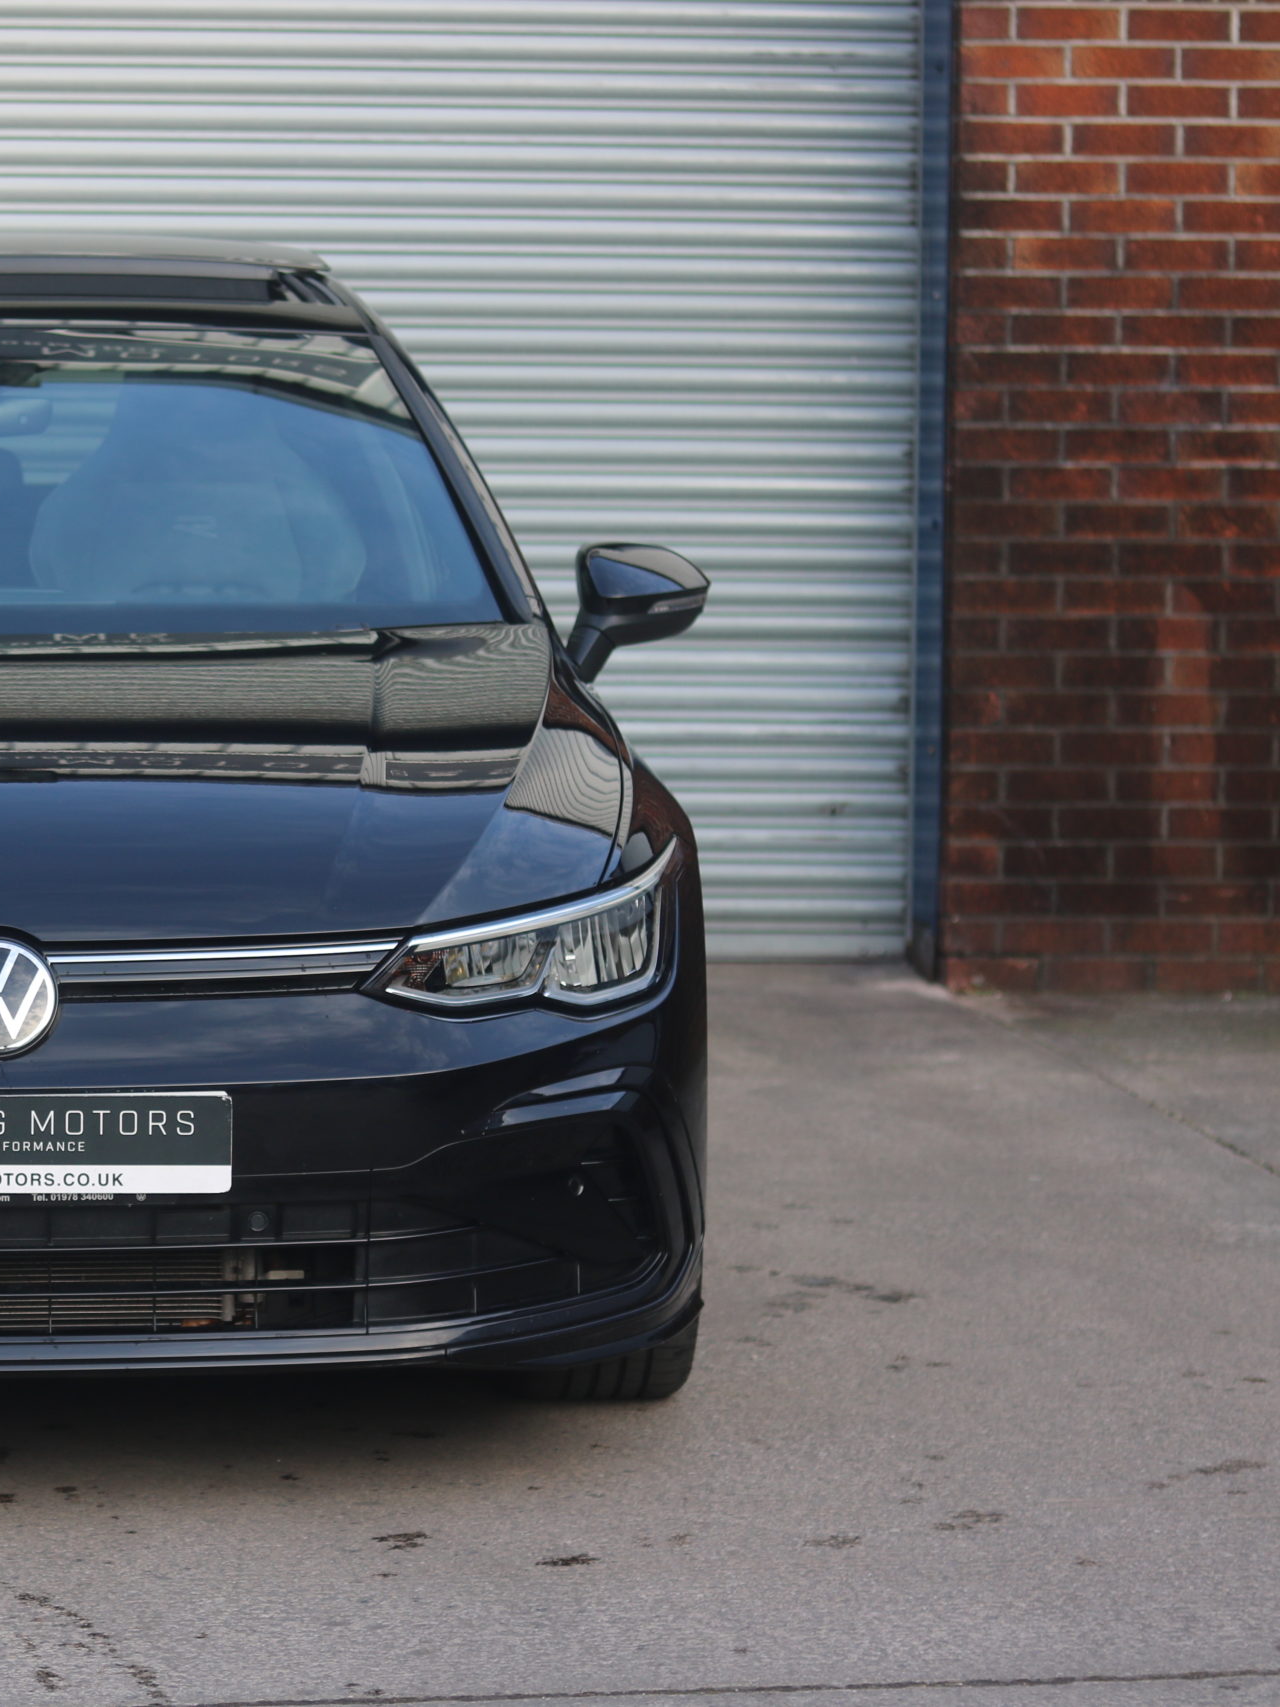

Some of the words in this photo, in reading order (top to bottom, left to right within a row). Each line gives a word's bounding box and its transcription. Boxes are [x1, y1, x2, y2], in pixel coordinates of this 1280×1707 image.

[30, 1109, 195, 1136] MOTORS
[32, 1193, 48, 1202] Tel.
[50, 1192, 79, 1202] 01978
